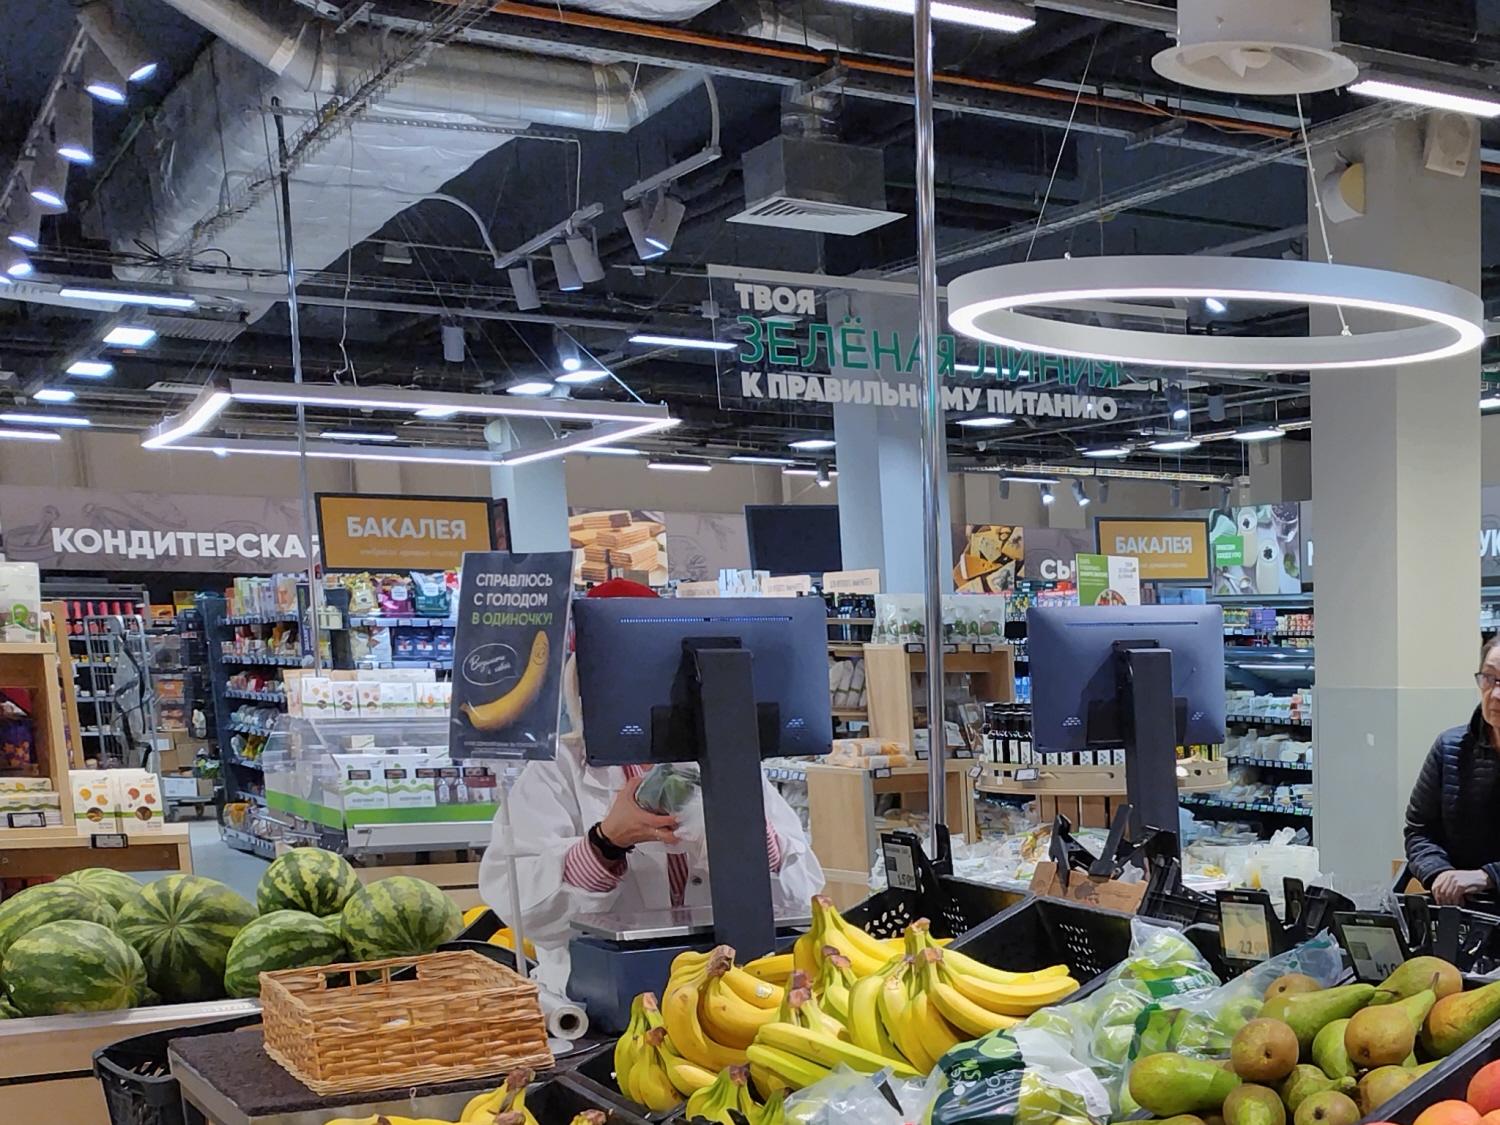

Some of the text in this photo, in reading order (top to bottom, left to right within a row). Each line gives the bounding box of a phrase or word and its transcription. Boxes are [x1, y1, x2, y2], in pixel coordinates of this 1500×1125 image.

[735, 283, 816, 315] ТВОЯ
[740, 371, 1118, 421] К ПРАВИЛЬНМУ ПИТАНИЮ
[346, 516, 467, 540] БАКАЛЕЯ
[1115, 535, 1192, 554] БАКАЛЕЯ
[1040, 558, 1075, 580] СЫ
[476, 573, 553, 587] СПРАВЛЮСЬ
[473, 592, 548, 608] С ГОЛОДОМ
[472, 612, 553, 627] В ОДИНОЧКУ!
